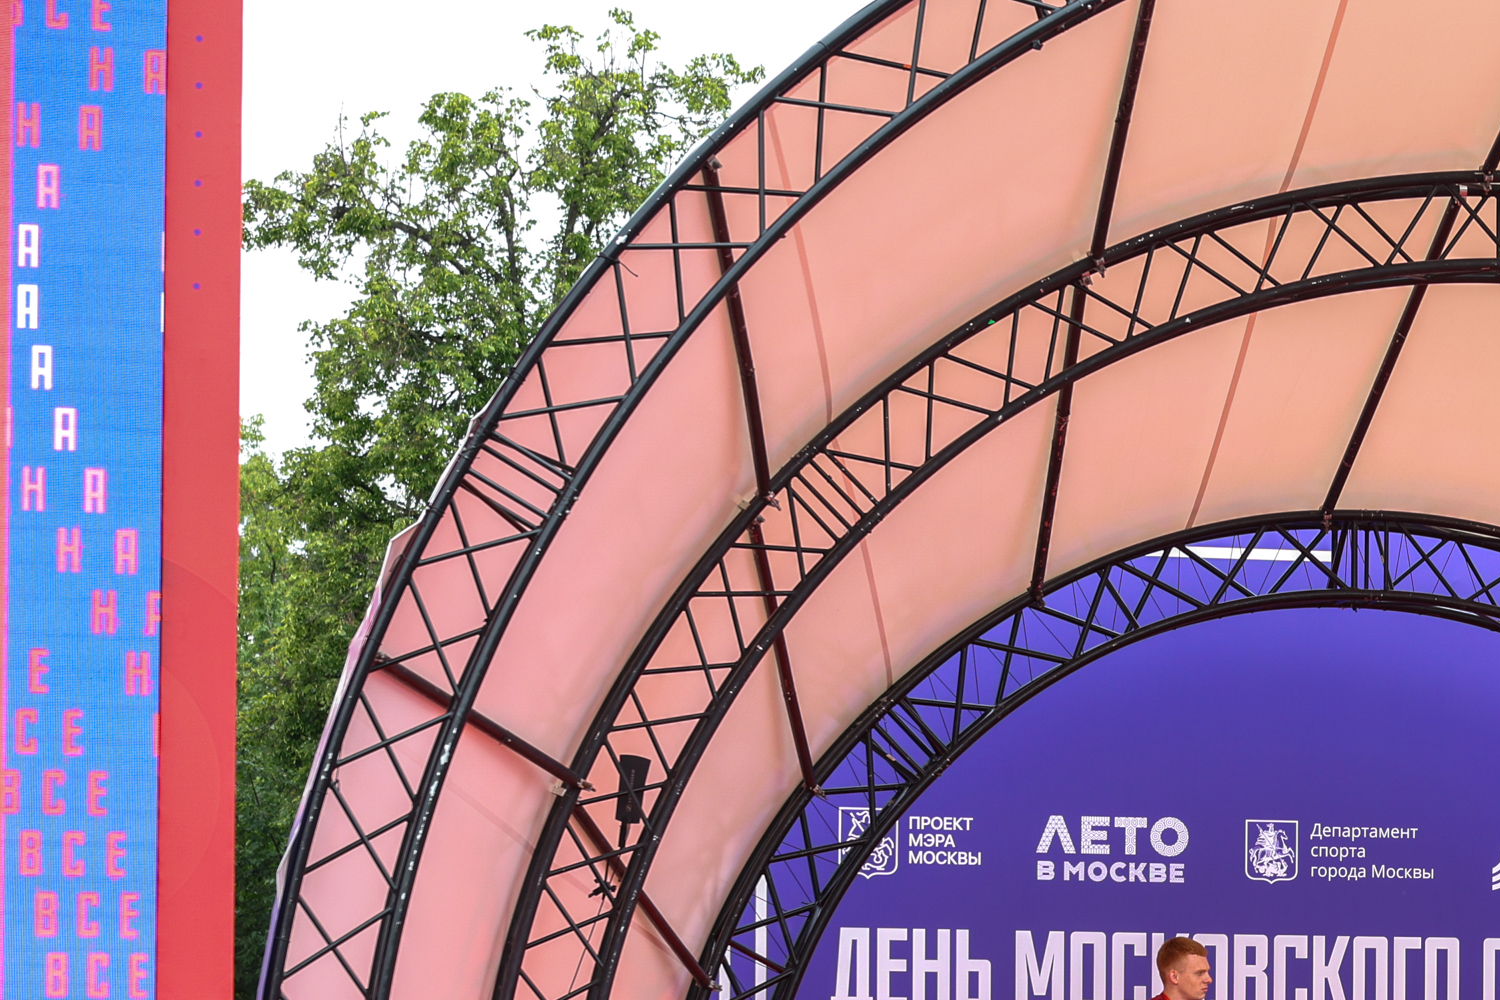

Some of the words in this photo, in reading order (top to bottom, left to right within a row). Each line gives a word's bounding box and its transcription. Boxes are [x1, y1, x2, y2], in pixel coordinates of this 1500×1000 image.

[908, 815, 974, 831] ПРОЕКТ
[1310, 822, 1419, 841] Департамент
[908, 833, 956, 848] МЭРА
[1035, 814, 1190, 858] ЛЕТО
[908, 850, 982, 866] МОСКВЫ
[1310, 844, 1366, 862] спорта
[1036, 860, 1056, 881] В
[1063, 860, 1185, 884] МОСКВЕ
[1310, 864, 1367, 882] города
[1371, 864, 1434, 880] Москвы
[34, 888, 140, 941] ВСЕ
[45, 951, 149, 1000] ВСЕ
